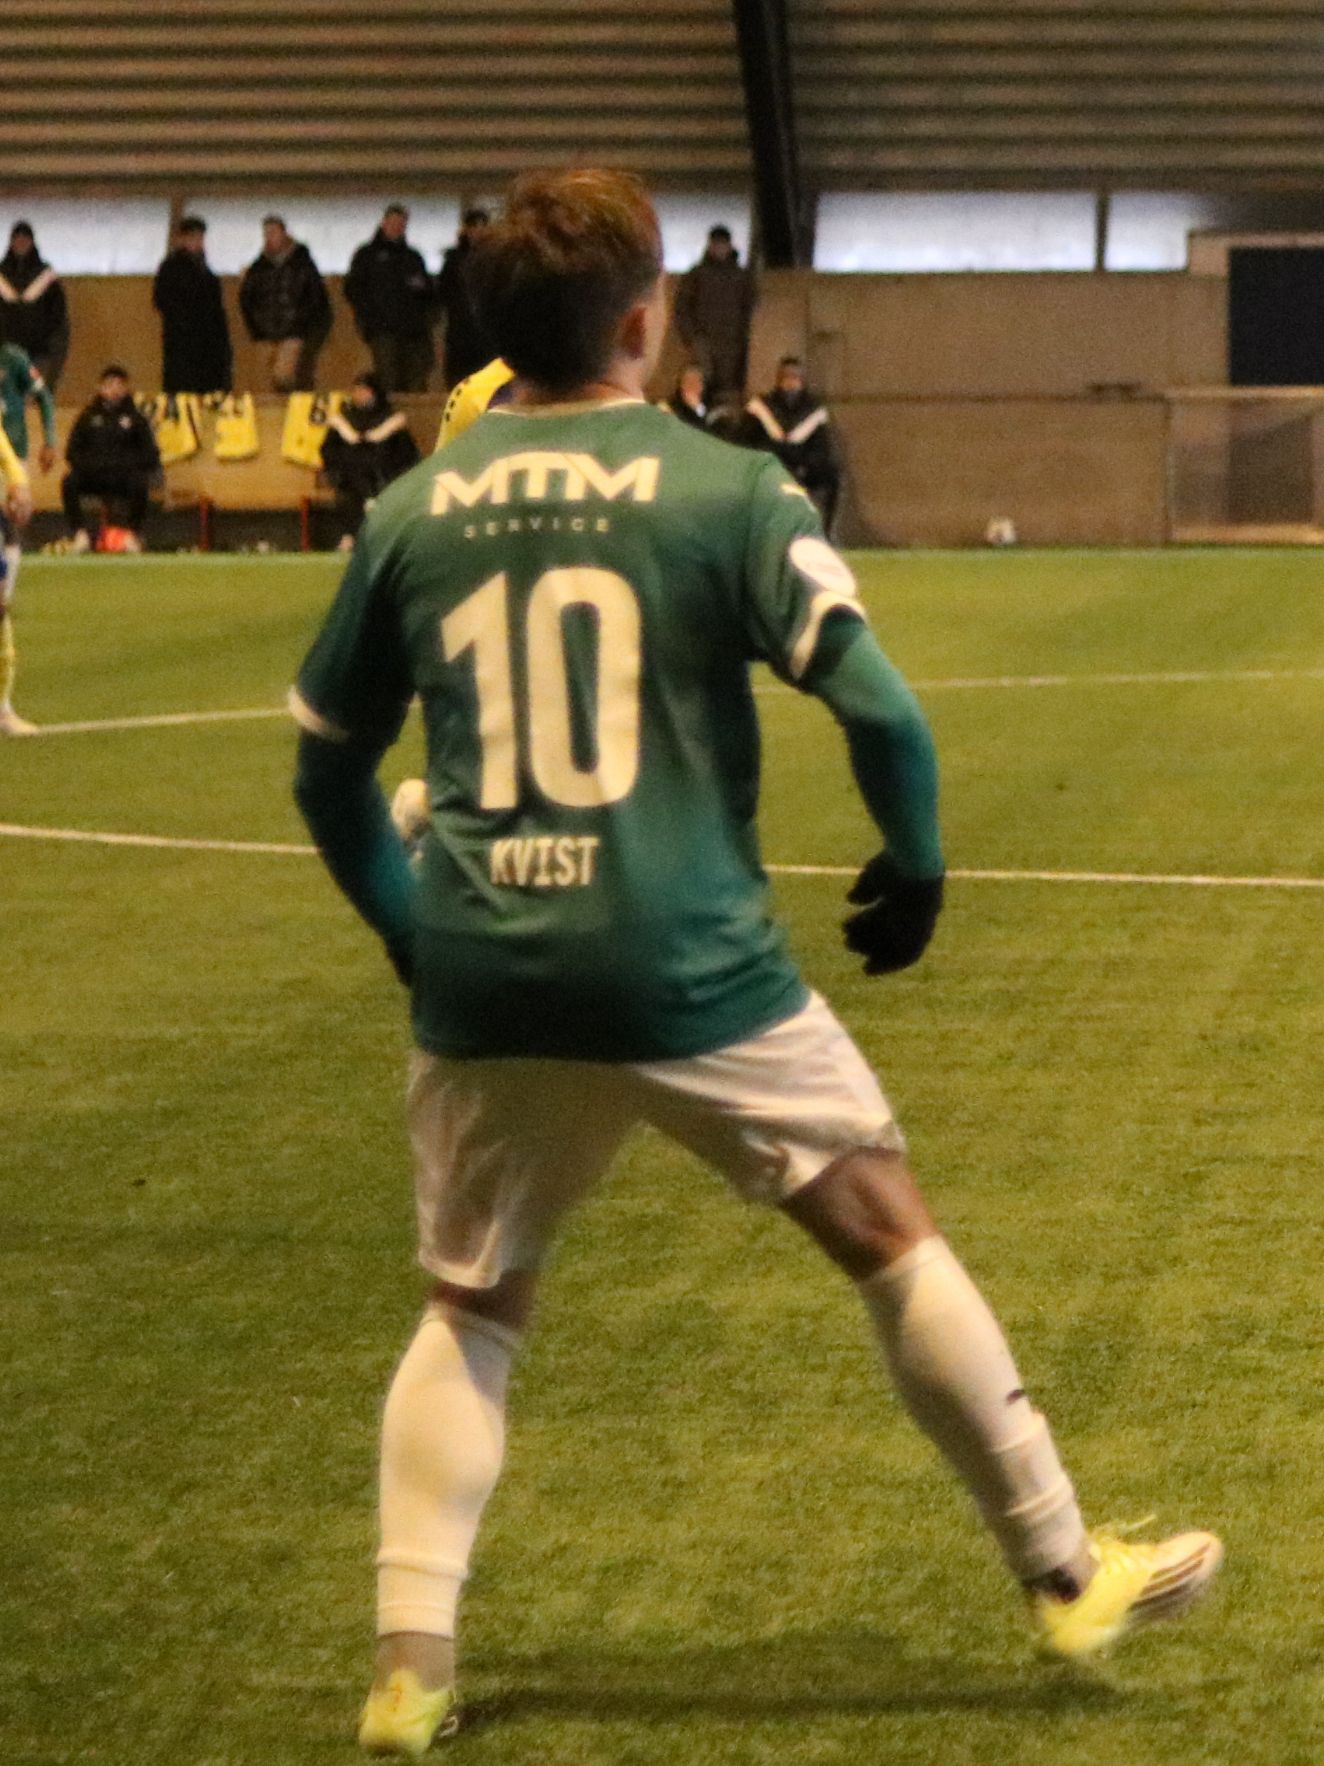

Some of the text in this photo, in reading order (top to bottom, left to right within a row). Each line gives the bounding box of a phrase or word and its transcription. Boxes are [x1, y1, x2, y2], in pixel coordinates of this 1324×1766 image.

[431, 451, 660, 516] MTM
[464, 517, 609, 540] SERVICE
[441, 566, 642, 809] 10
[491, 836, 599, 887] KVIST
